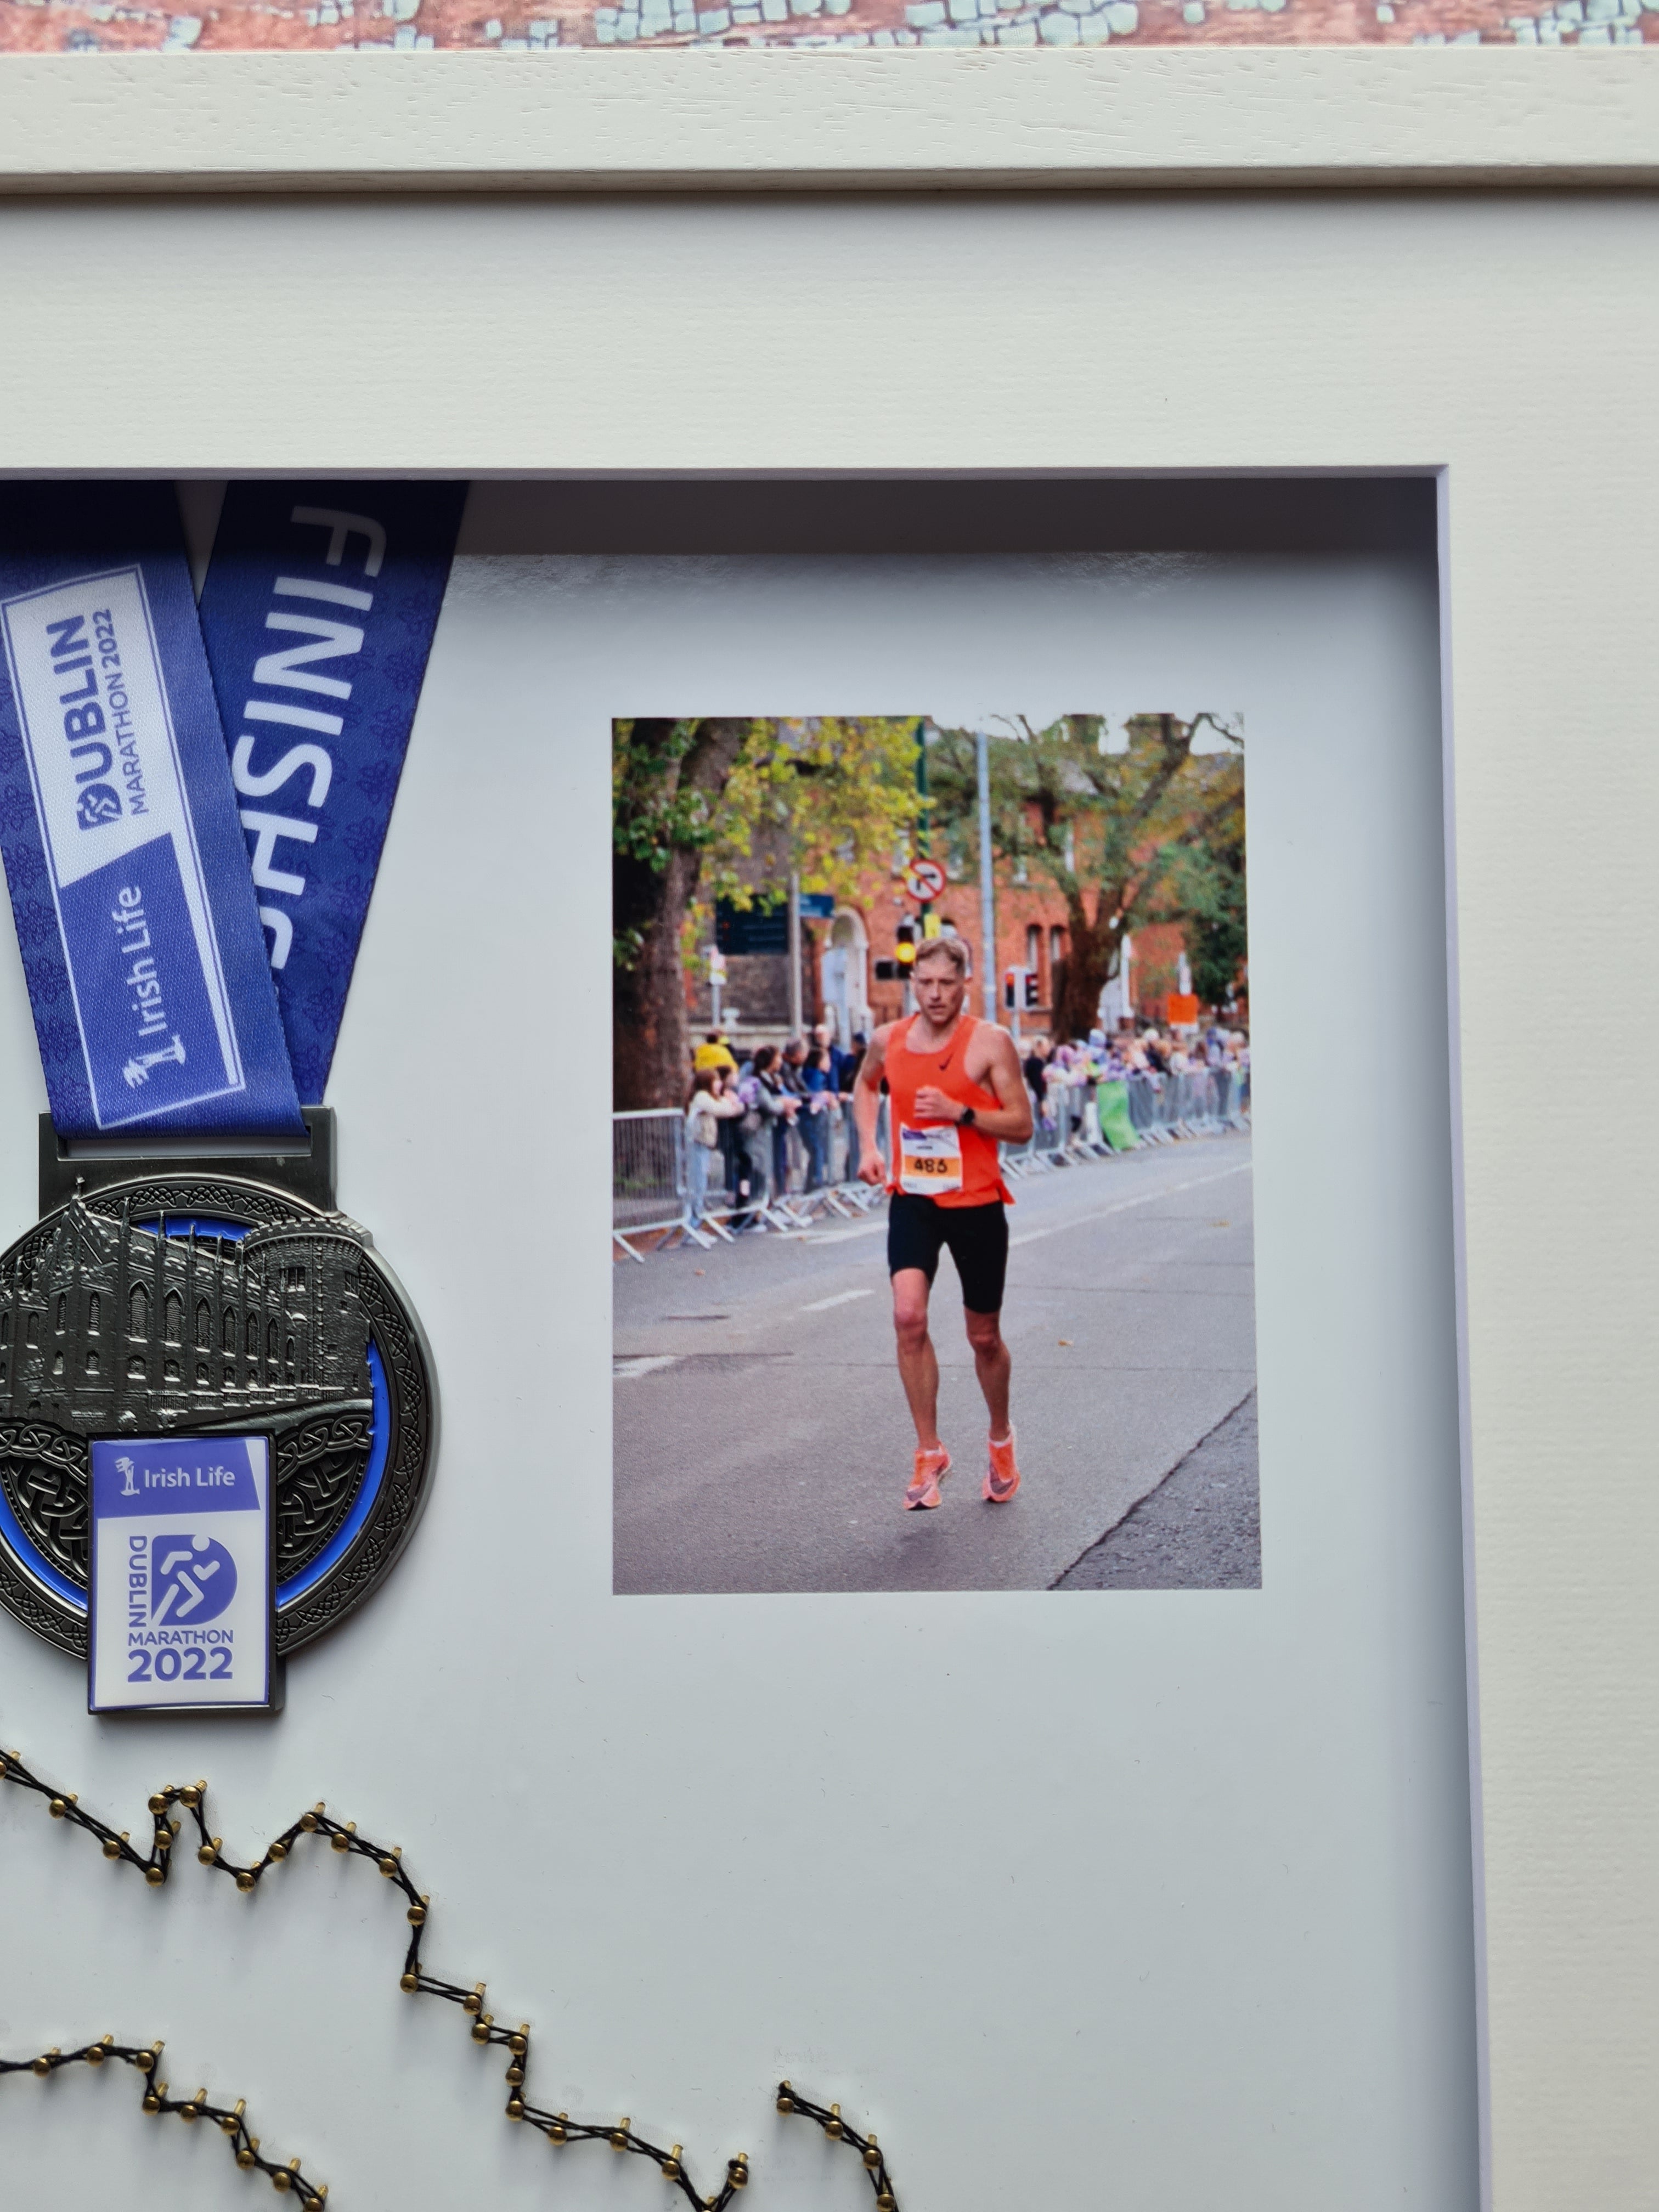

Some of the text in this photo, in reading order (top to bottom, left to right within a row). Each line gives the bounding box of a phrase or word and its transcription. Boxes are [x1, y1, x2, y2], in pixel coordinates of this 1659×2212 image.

[46, 614, 122, 831] DUBLIN
[93, 608, 149, 816] MARATHON 2022
[233, 505, 386, 997] FINISH
[112, 885, 168, 1037] Irish Life
[144, 1466, 235, 1488] Irish Life
[128, 1536, 148, 1628] DUBLIN
[128, 1629, 234, 1646] MARATHON
[127, 1646, 233, 1683] 2022
